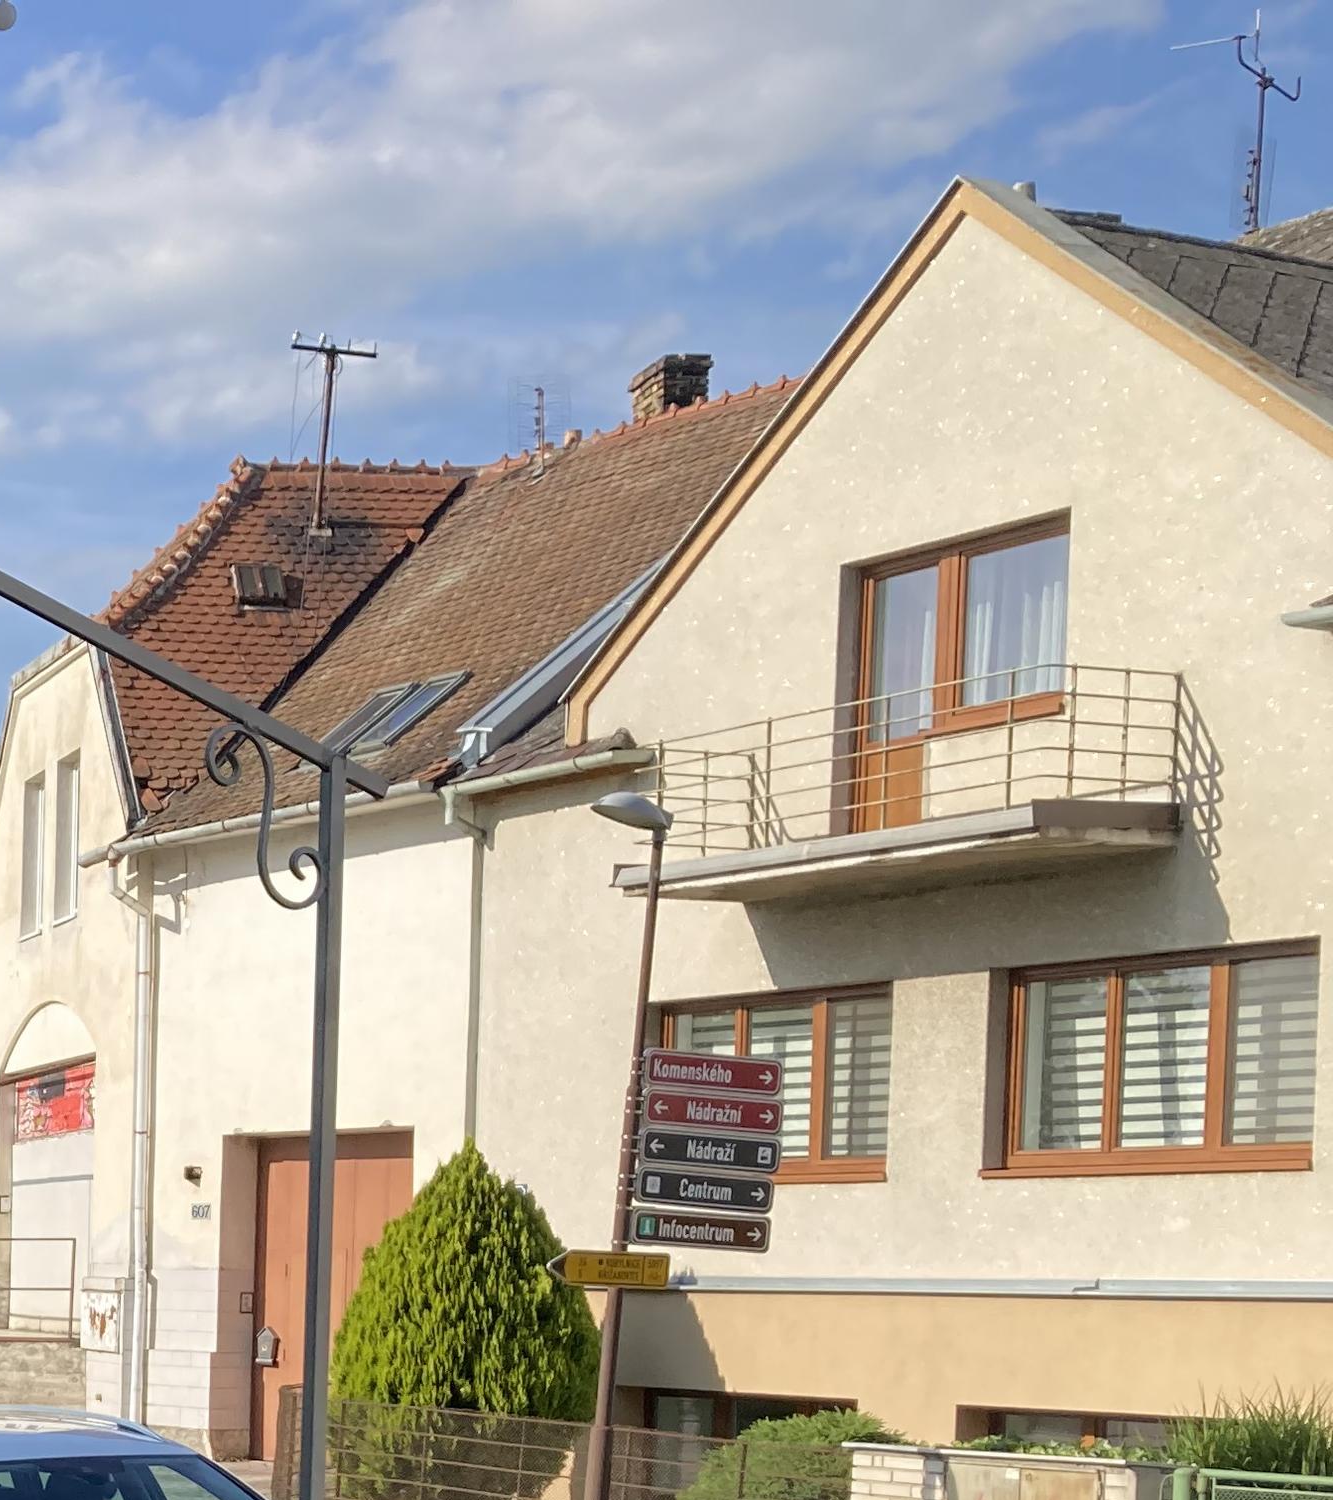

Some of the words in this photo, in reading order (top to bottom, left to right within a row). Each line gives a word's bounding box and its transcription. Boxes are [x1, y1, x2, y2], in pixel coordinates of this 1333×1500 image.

[653, 1058, 732, 1083] Komenského
[687, 1100, 742, 1124] Nádražní
[687, 1139, 737, 1162] Nádraží
[679, 1178, 732, 1201] Centrum
[191, 1203, 211, 1218] 607
[658, 1218, 735, 1243] Infocentrum
